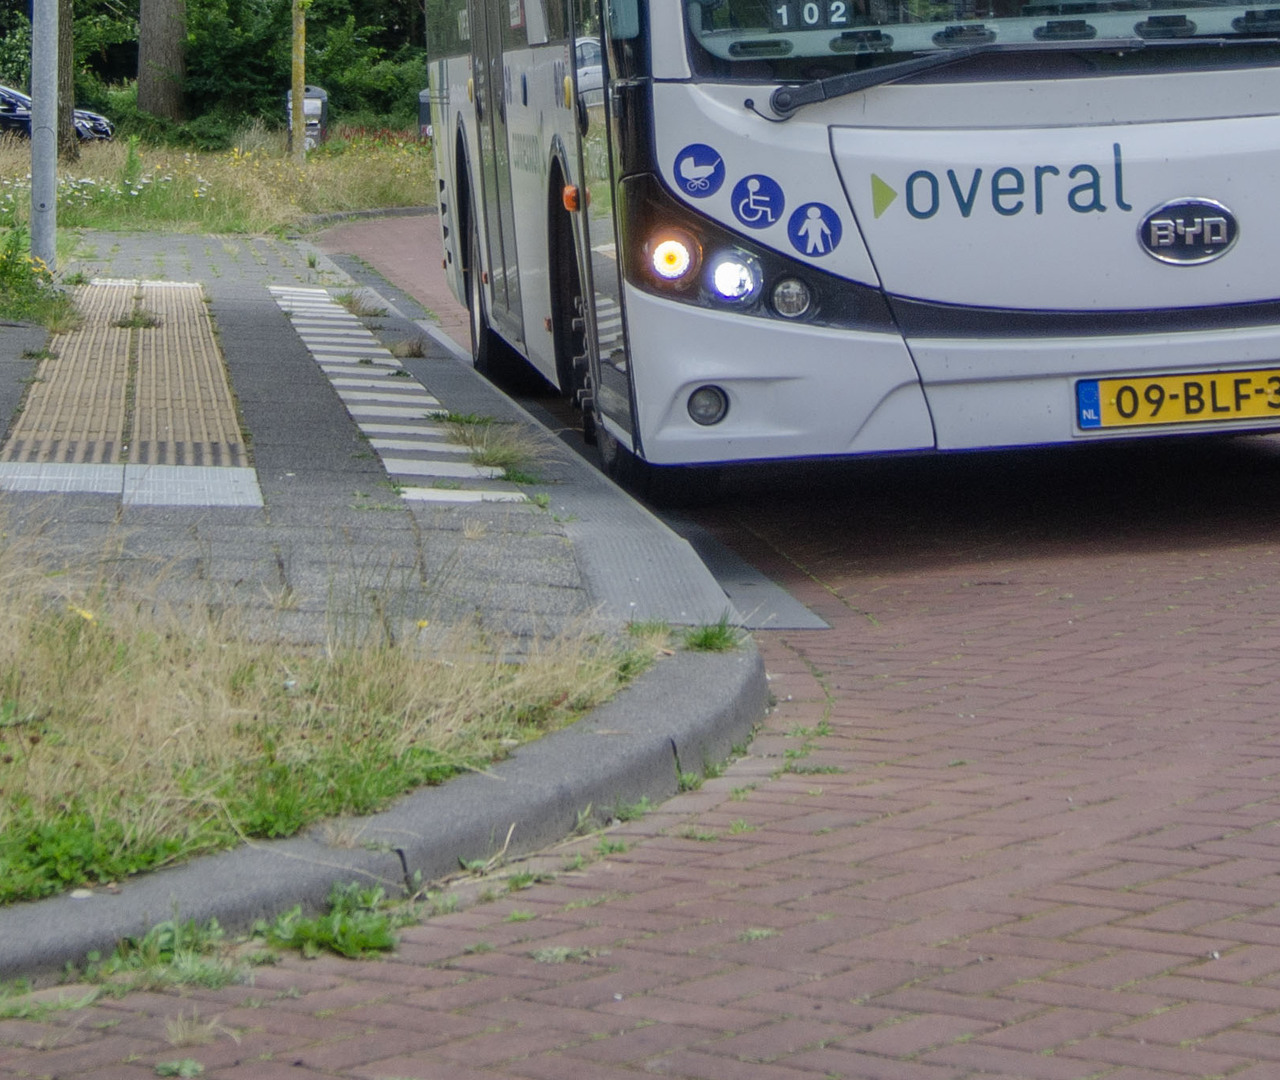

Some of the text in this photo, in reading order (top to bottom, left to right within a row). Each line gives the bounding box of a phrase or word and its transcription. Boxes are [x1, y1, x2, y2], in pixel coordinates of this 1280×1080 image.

[776, 1, 847, 26] 102
[905, 142, 1133, 220] overal
[1150, 217, 1228, 246] BYD
[1082, 409, 1099, 420] NL
